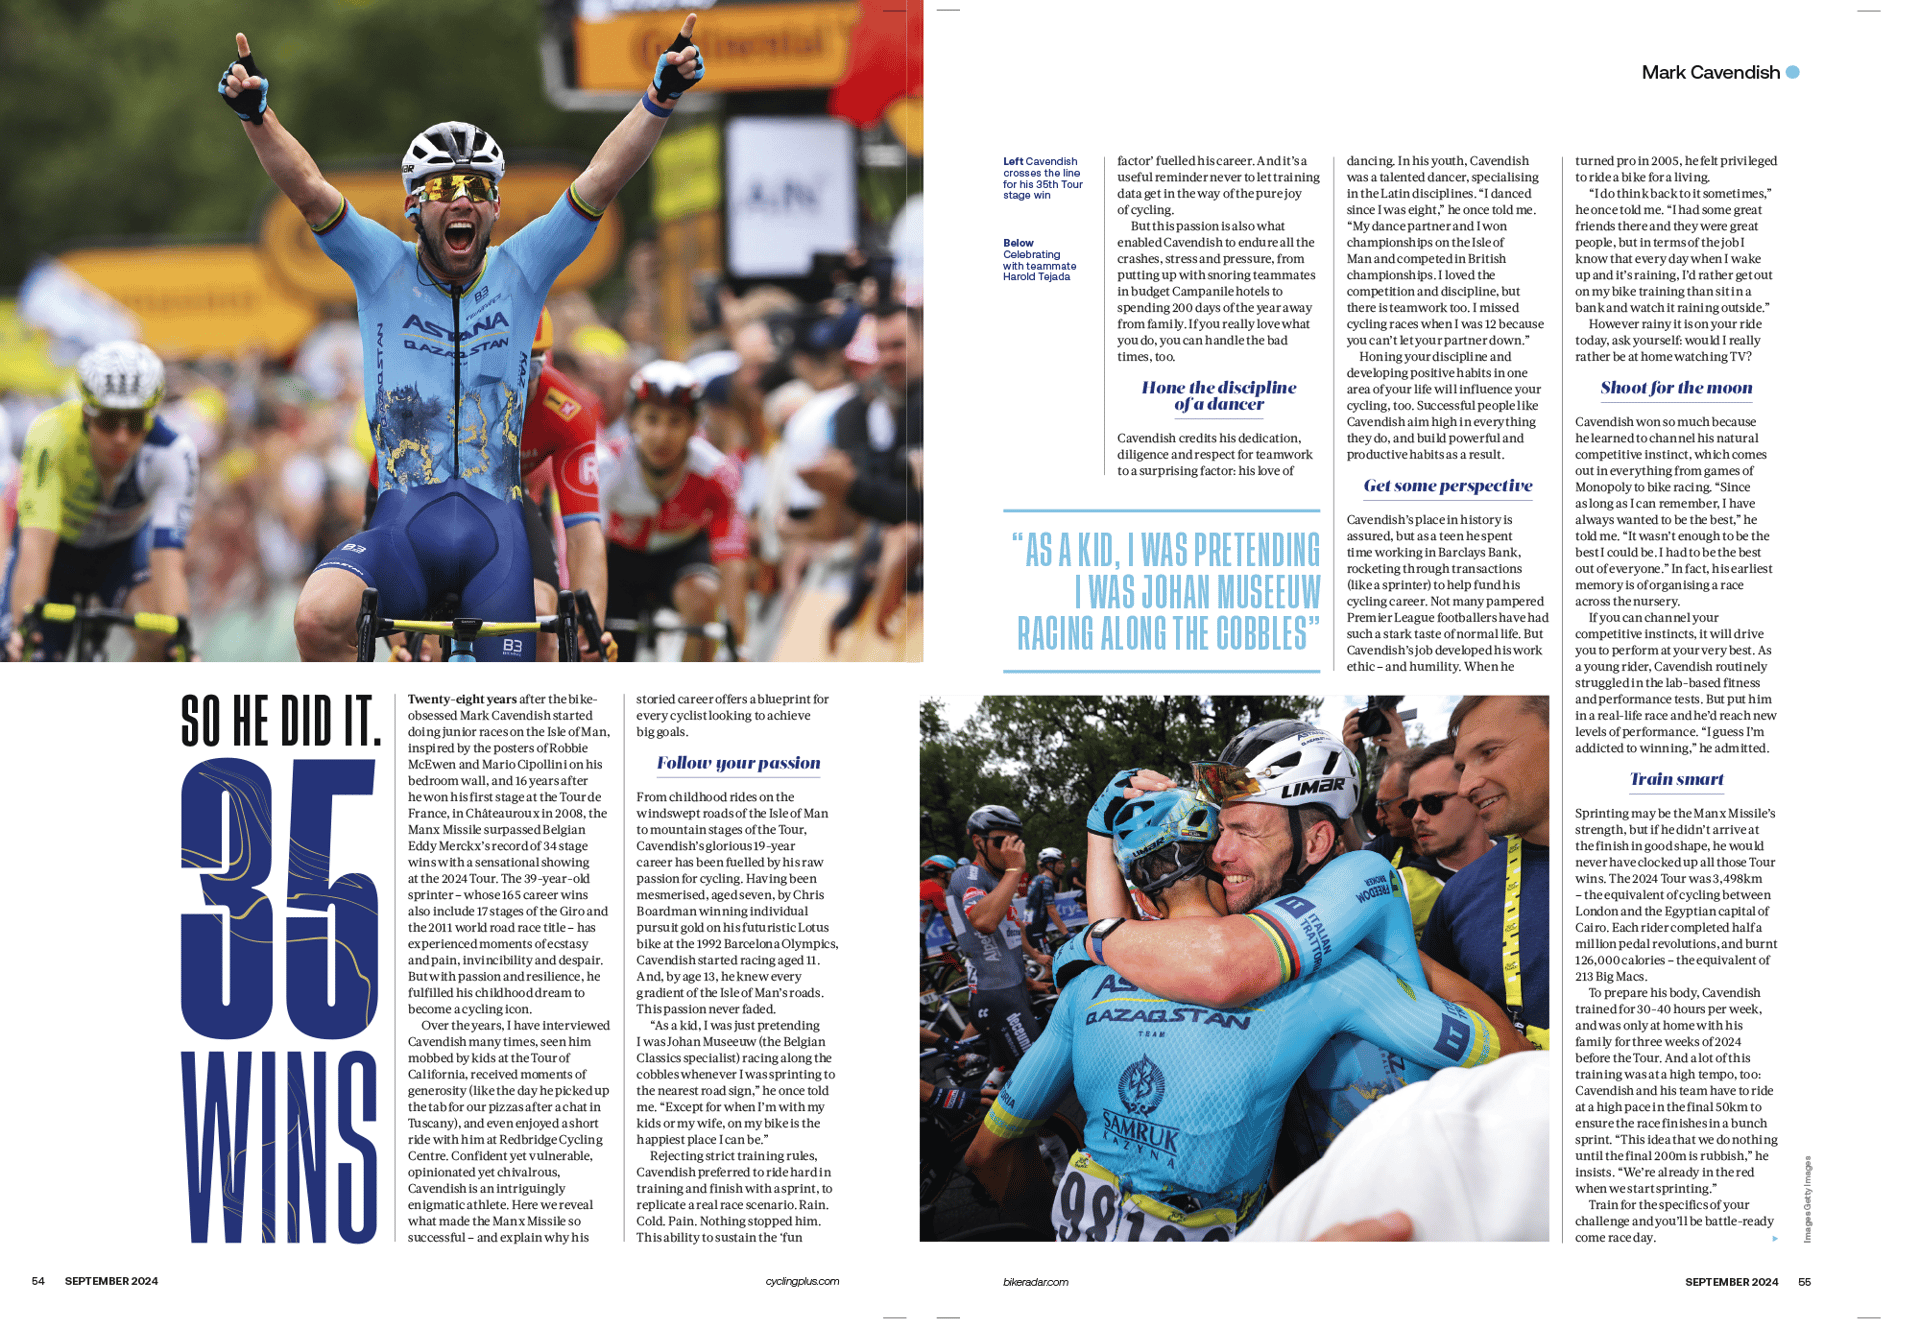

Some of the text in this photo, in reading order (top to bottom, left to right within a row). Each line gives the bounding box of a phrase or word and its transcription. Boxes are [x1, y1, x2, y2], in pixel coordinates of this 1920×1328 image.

[1643, 65, 1780, 79] Mark Cavendish
[1004, 157, 1077, 165] Left Cavendish
[1347, 156, 1529, 168] dancing. In his youth, Cavendish
[1044, 169, 1060, 177] the
[1063, 169, 1080, 177] line
[1003, 180, 1083, 188] for his 35th Tour
[1004, 191, 1050, 201] stage win
[1004, 239, 1034, 247] Below
[1004, 250, 1060, 260] Celebrating
[1003, 262, 1076, 270] with teammate
[1004, 272, 1071, 282] Harold Tejada
[1142, 380, 1297, 396] Hone the discipline
[1601, 380, 1752, 397] Shoot for the moon
[1175, 397, 1265, 413] of a dancer
[1118, 433, 1301, 444] Cavendish credits his dedication,
[1364, 479, 1533, 495] Get some perspective
[1059, 532, 1071, 566] A
[1079, 532, 1120, 570] KID,
[1129, 532, 1133, 566] I
[1141, 532, 1187, 566] WAS
[1195, 532, 1319, 566] PRETENDING
[1347, 547, 1521, 560] time working in Barclays Bank,
[1076, 574, 1321, 609] I WAS JOHAN MUSEEUW
[1018, 615, 1093, 650] RACING
[1101, 615, 1166, 650] ALONG
[1173, 616, 1208, 650] THE
[1575, 629, 1764, 641] competitive instincts, it will drive
[503, 638, 523, 653] B3
[408, 694, 597, 706] Twenty-eight years after the bike-
[182, 694, 381, 747] SO HE DID IT.
[657, 756, 820, 773] Follow your passion
[1631, 772, 1724, 785] Train smart
[637, 792, 794, 802] From childhood rides on the
[181, 758, 378, 1040] 35
[1355, 884, 1391, 903] FREEDOM
[1308, 913, 1332, 955] ITALIAN
[1576, 971, 1647, 984] 213 Big Macs.
[1589, 988, 1761, 1000] To prepare his body, Cavendish
[1086, 1008, 1251, 1030] QAZAQSTAN
[1138, 1030, 1166, 1038] TEAM
[408, 1036, 467, 1047] Cavendish
[469, 1039, 501, 1049] many
[503, 1037, 538, 1048] times,
[568, 1037, 591, 1046] him
[1103, 1110, 1180, 1153] SAMRUK
[181, 1051, 377, 1244] WINS
[408, 1151, 592, 1163] Centre. Confident yet vulnerable,
[1804, 1156, 1813, 1243] Images Getty Images
[637, 1216, 821, 1228] Cold. Pain. Nothing stopped him.
[32, 1277, 45, 1285] 54
[65, 1277, 158, 1285] SEPTEMBER 2024
[766, 1277, 839, 1287] cyclingplus.com
[1003, 1278, 1069, 1286] bikeradar.com
[1686, 1278, 1779, 1286] SEPTEMBER 2024
[1799, 1278, 1811, 1286] 55
